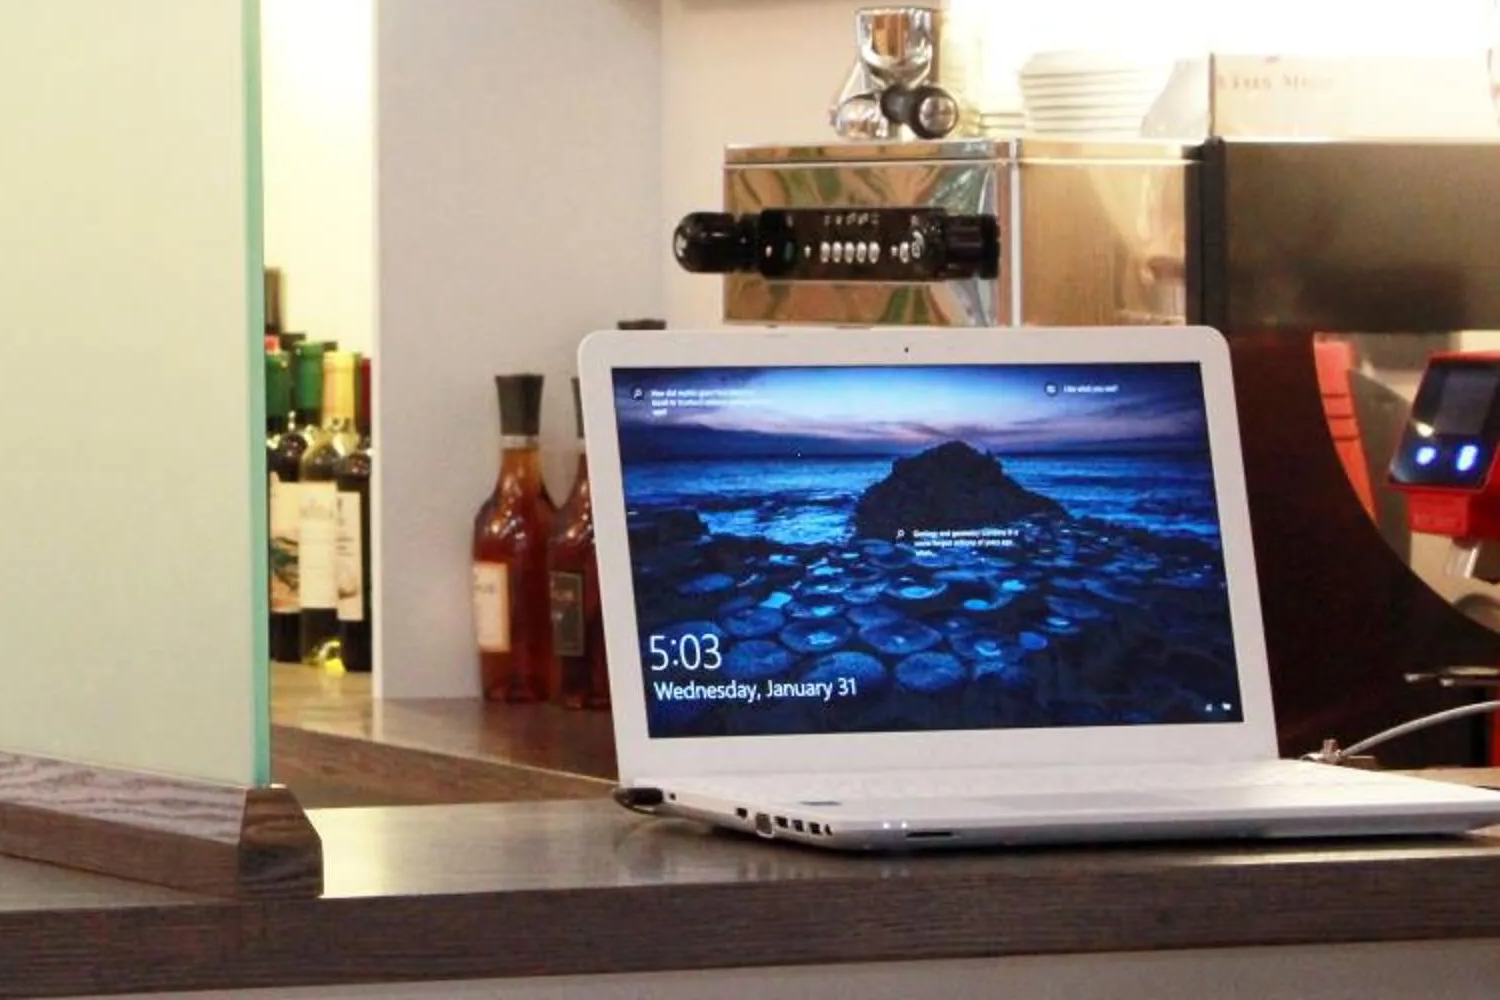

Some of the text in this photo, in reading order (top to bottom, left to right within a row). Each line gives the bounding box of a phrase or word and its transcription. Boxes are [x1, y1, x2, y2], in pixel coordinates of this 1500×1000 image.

[650, 633, 722, 671] 5:03
[653, 677, 857, 703] Wednesday, January 31
